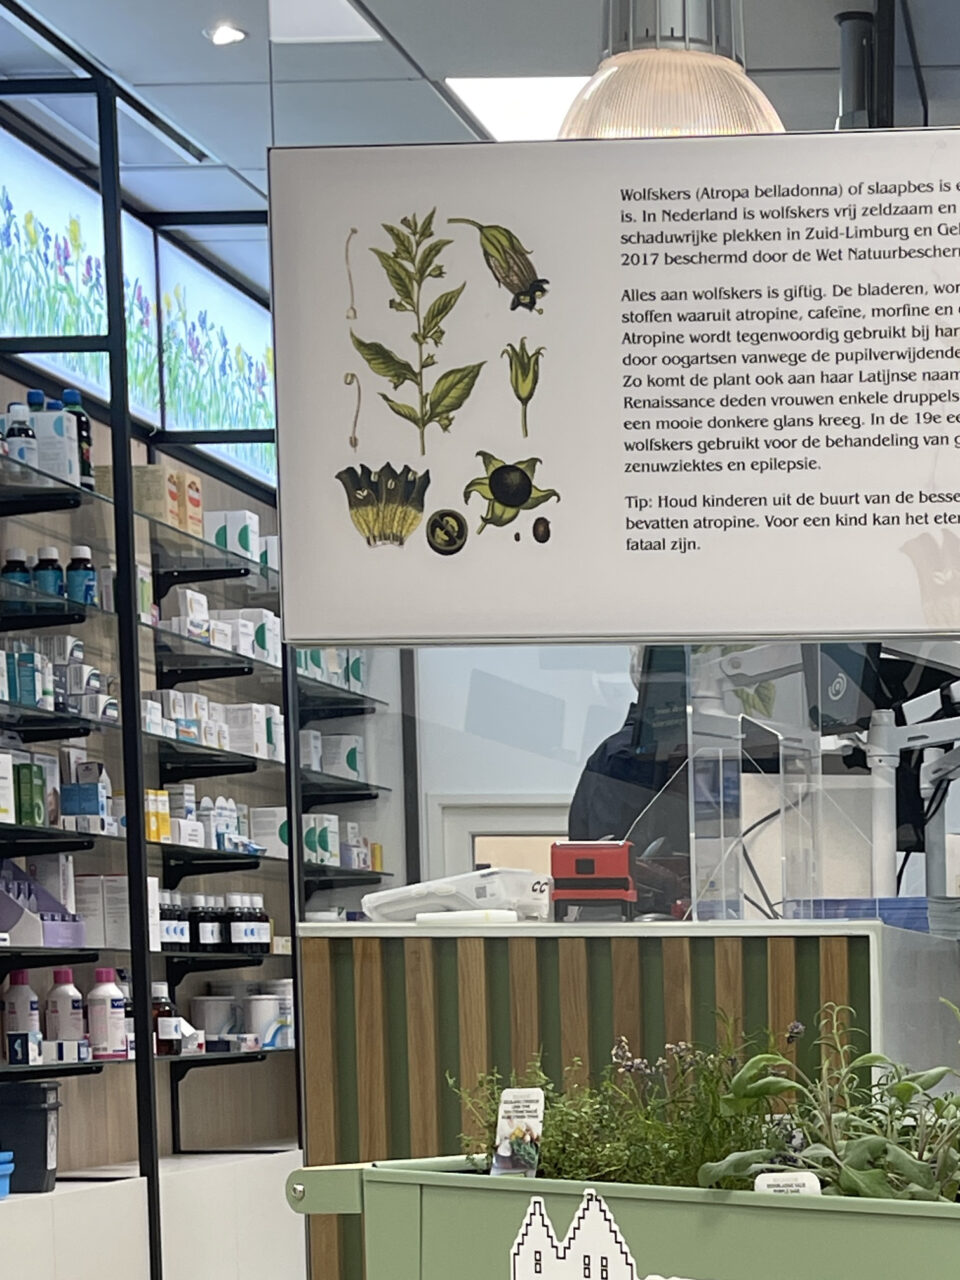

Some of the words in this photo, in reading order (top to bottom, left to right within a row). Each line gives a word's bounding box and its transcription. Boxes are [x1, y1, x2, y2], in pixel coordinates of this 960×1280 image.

[619, 187, 691, 202] Wolfskers
[695, 186, 750, 202] (Atropa
[753, 183, 843, 198] belladonna)
[847, 181, 863, 196] of
[866, 180, 935, 197] slaapbes
[938, 178, 952, 192] is
[620, 209, 637, 223] is.
[642, 209, 657, 223] In
[661, 206, 738, 222] Nederland
[742, 206, 755, 220] is
[758, 204, 830, 219] wolfskers
[833, 203, 857, 221] vrij
[860, 202, 933, 217] zeldzaam
[937, 203, 957, 214] en
[619, 229, 718, 246] schaduwrijke
[722, 228, 782, 245] plekken
[786, 226, 801, 240] in
[804, 224, 909, 241] Zuid-Limburg
[912, 226, 933, 237] en
[620, 252, 660, 265] 2017
[663, 249, 748, 265] beschermd
[751, 249, 789, 263] door
[791, 248, 812, 262] de
[815, 248, 844, 262] Wet
[620, 288, 657, 302] Alles
[659, 290, 688, 301] aan
[691, 286, 763, 300] wolfskers
[766, 285, 780, 299] is
[782, 284, 827, 302] giftig.
[831, 284, 854, 297] De
[857, 282, 929, 297] bladeren,
[621, 309, 672, 323] stoffen
[676, 308, 731, 322] waaruit
[735, 306, 803, 324] atropine,
[807, 305, 866, 319] cafeïne,
[871, 303, 930, 318] morfine
[934, 305, 954, 316] en
[620, 330, 685, 347] Atropine
[688, 329, 732, 343] wordt
[735, 327, 840, 345] tegenwoordig
[842, 325, 908, 344] gebruikt
[910, 324, 930, 342] bij
[623, 458, 724, 473] zenuwziektes
[726, 460, 746, 472] en
[749, 456, 822, 474] epilepsie.
[623, 495, 653, 512] Tip:
[657, 494, 698, 508] Houd
[702, 493, 768, 508] kinderen
[772, 492, 792, 506] uit
[795, 492, 815, 506] de
[819, 492, 860, 505] buurt
[863, 493, 891, 505] van
[894, 490, 915, 504] de
[625, 516, 689, 530] bevatten
[692, 514, 760, 532] atropine.
[764, 514, 800, 528] Voor
[802, 516, 831, 527] een
[835, 512, 868, 527] kind
[872, 512, 901, 526] kan
[905, 511, 930, 525] het
[625, 537, 666, 551] fataal
[670, 536, 701, 554] zijn.
